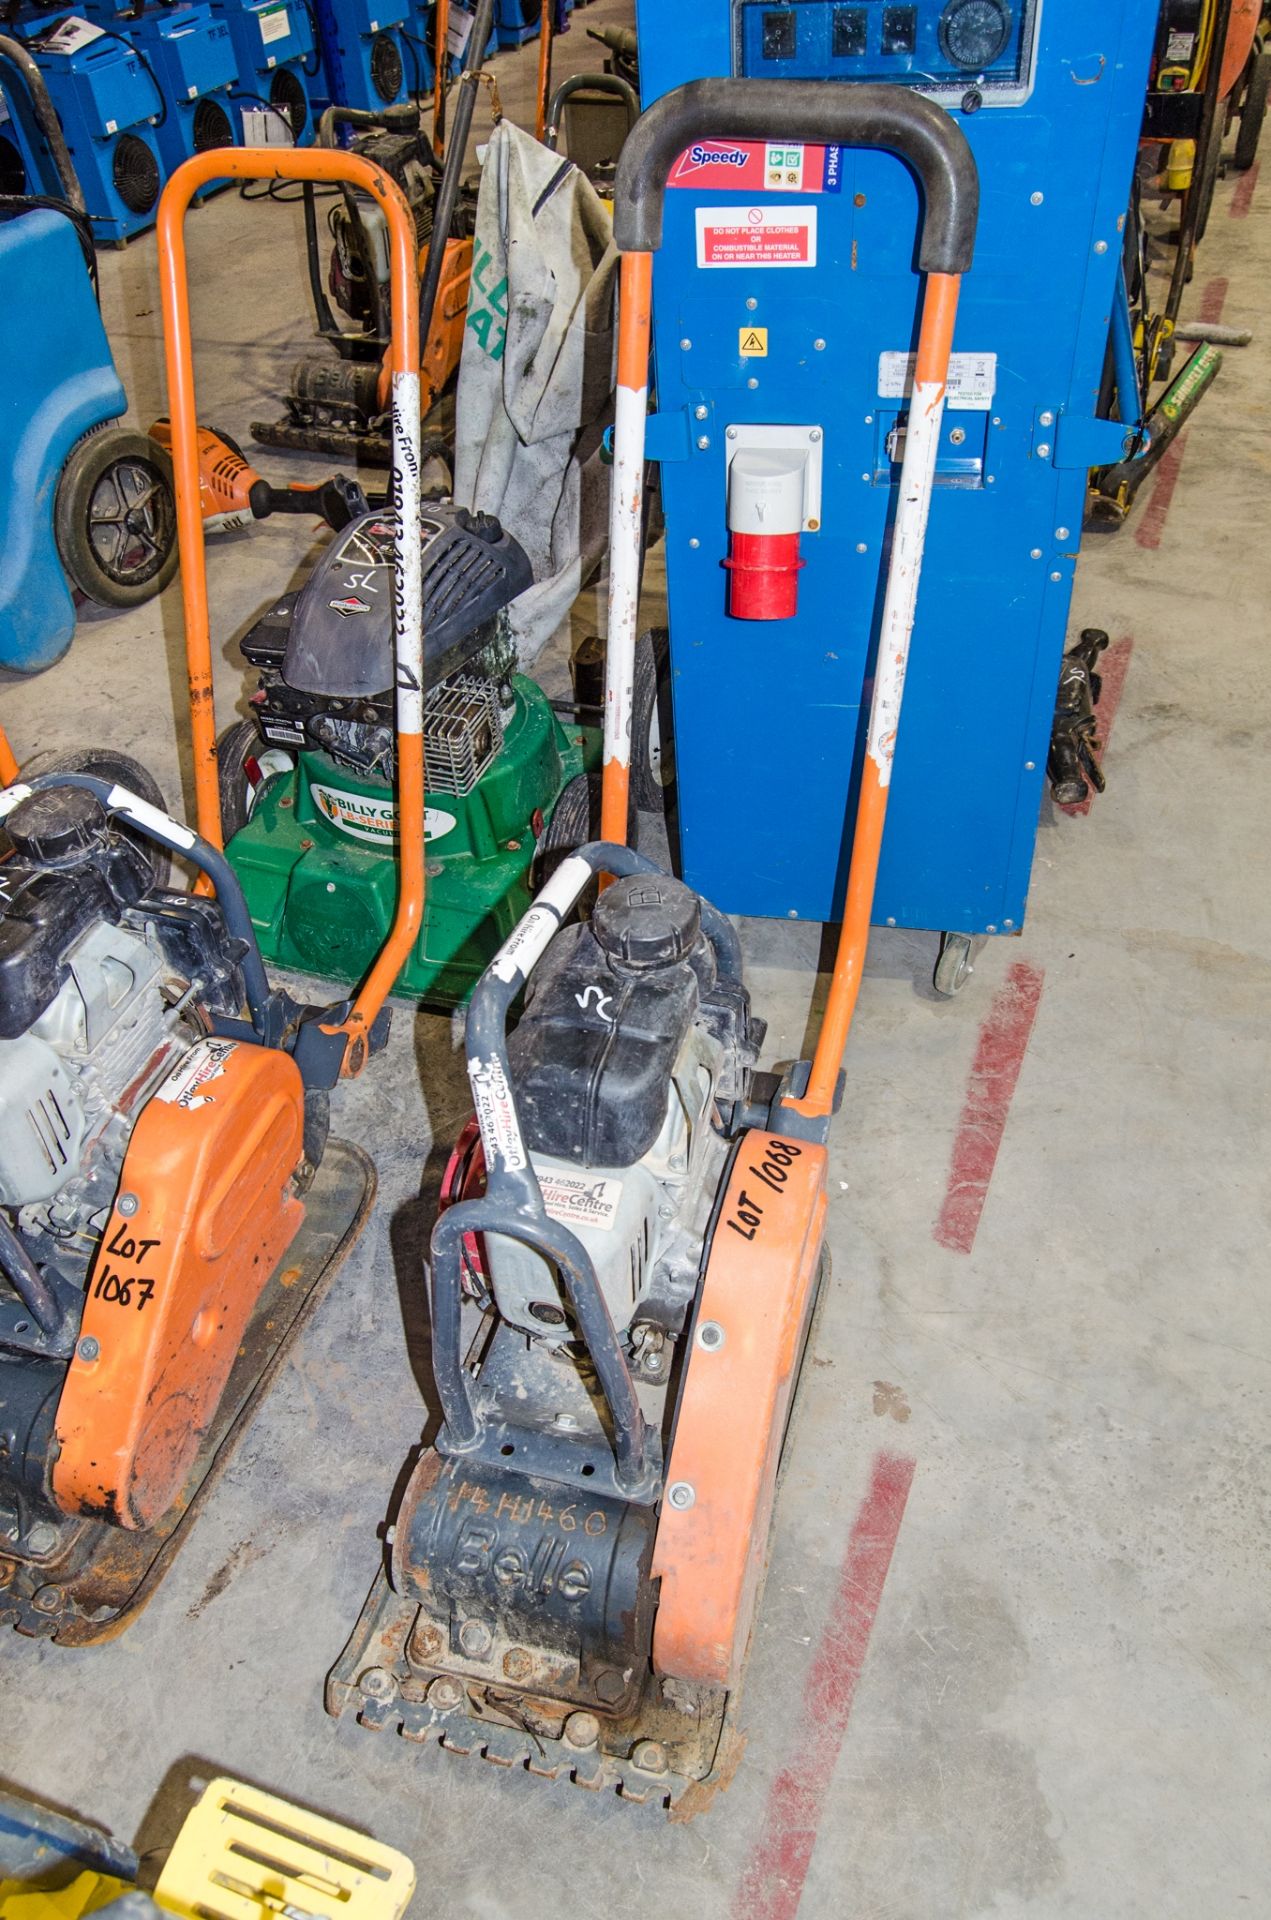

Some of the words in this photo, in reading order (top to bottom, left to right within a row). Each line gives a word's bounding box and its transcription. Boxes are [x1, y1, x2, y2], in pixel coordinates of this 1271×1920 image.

[691, 147, 748, 167] Speedy
[343, 570, 378, 593] SL
[338, 798, 378, 820] BILLY
[380, 810, 429, 820] GOT
[726, 1190, 764, 1241] LOT
[748, 1140, 802, 1194] 1068
[106, 1222, 162, 1264] LOT
[94, 1264, 155, 1312] 1067
[452, 1516, 593, 1602] Belle
